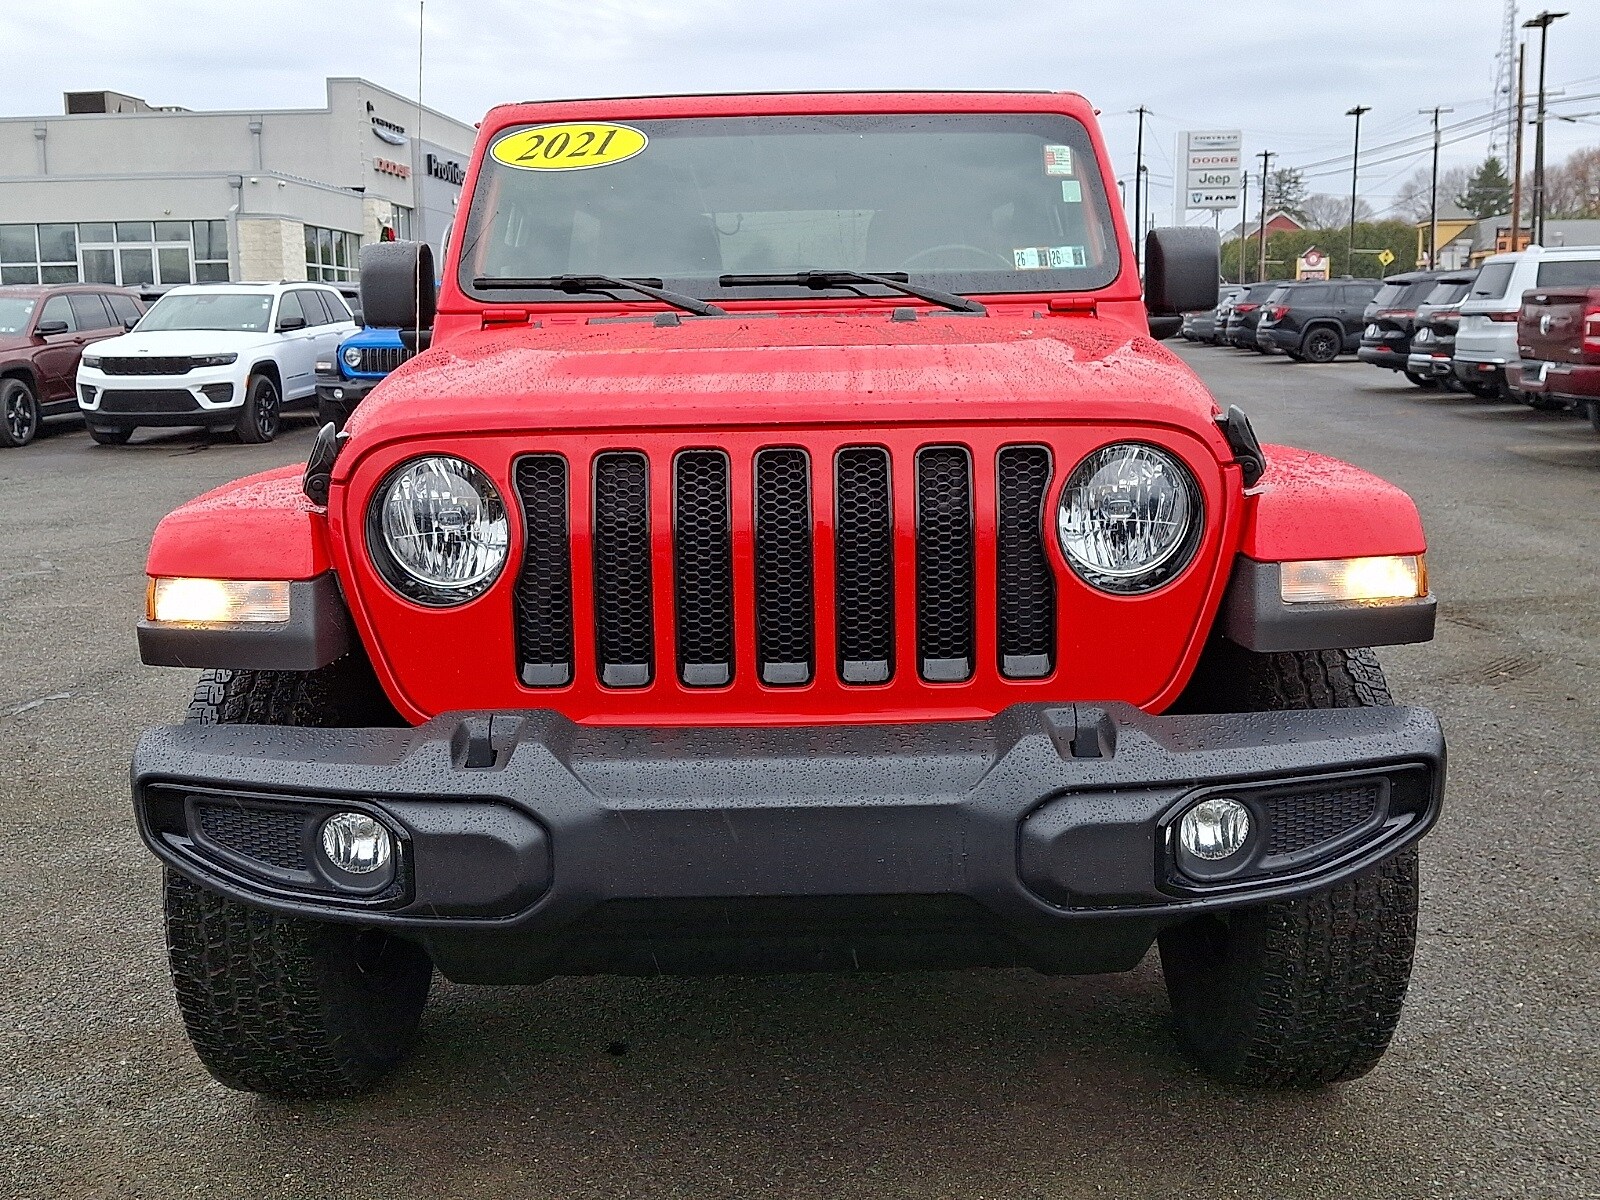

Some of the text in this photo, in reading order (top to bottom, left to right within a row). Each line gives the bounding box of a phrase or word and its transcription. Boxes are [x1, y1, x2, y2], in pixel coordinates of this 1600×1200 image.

[514, 129, 618, 162] 2021
[1192, 156, 1238, 164] DODGE
[373, 157, 411, 179] DODGE
[1198, 173, 1231, 186] Jeep
[1016, 251, 1026, 267] 26
[1052, 250, 1062, 265] 26
